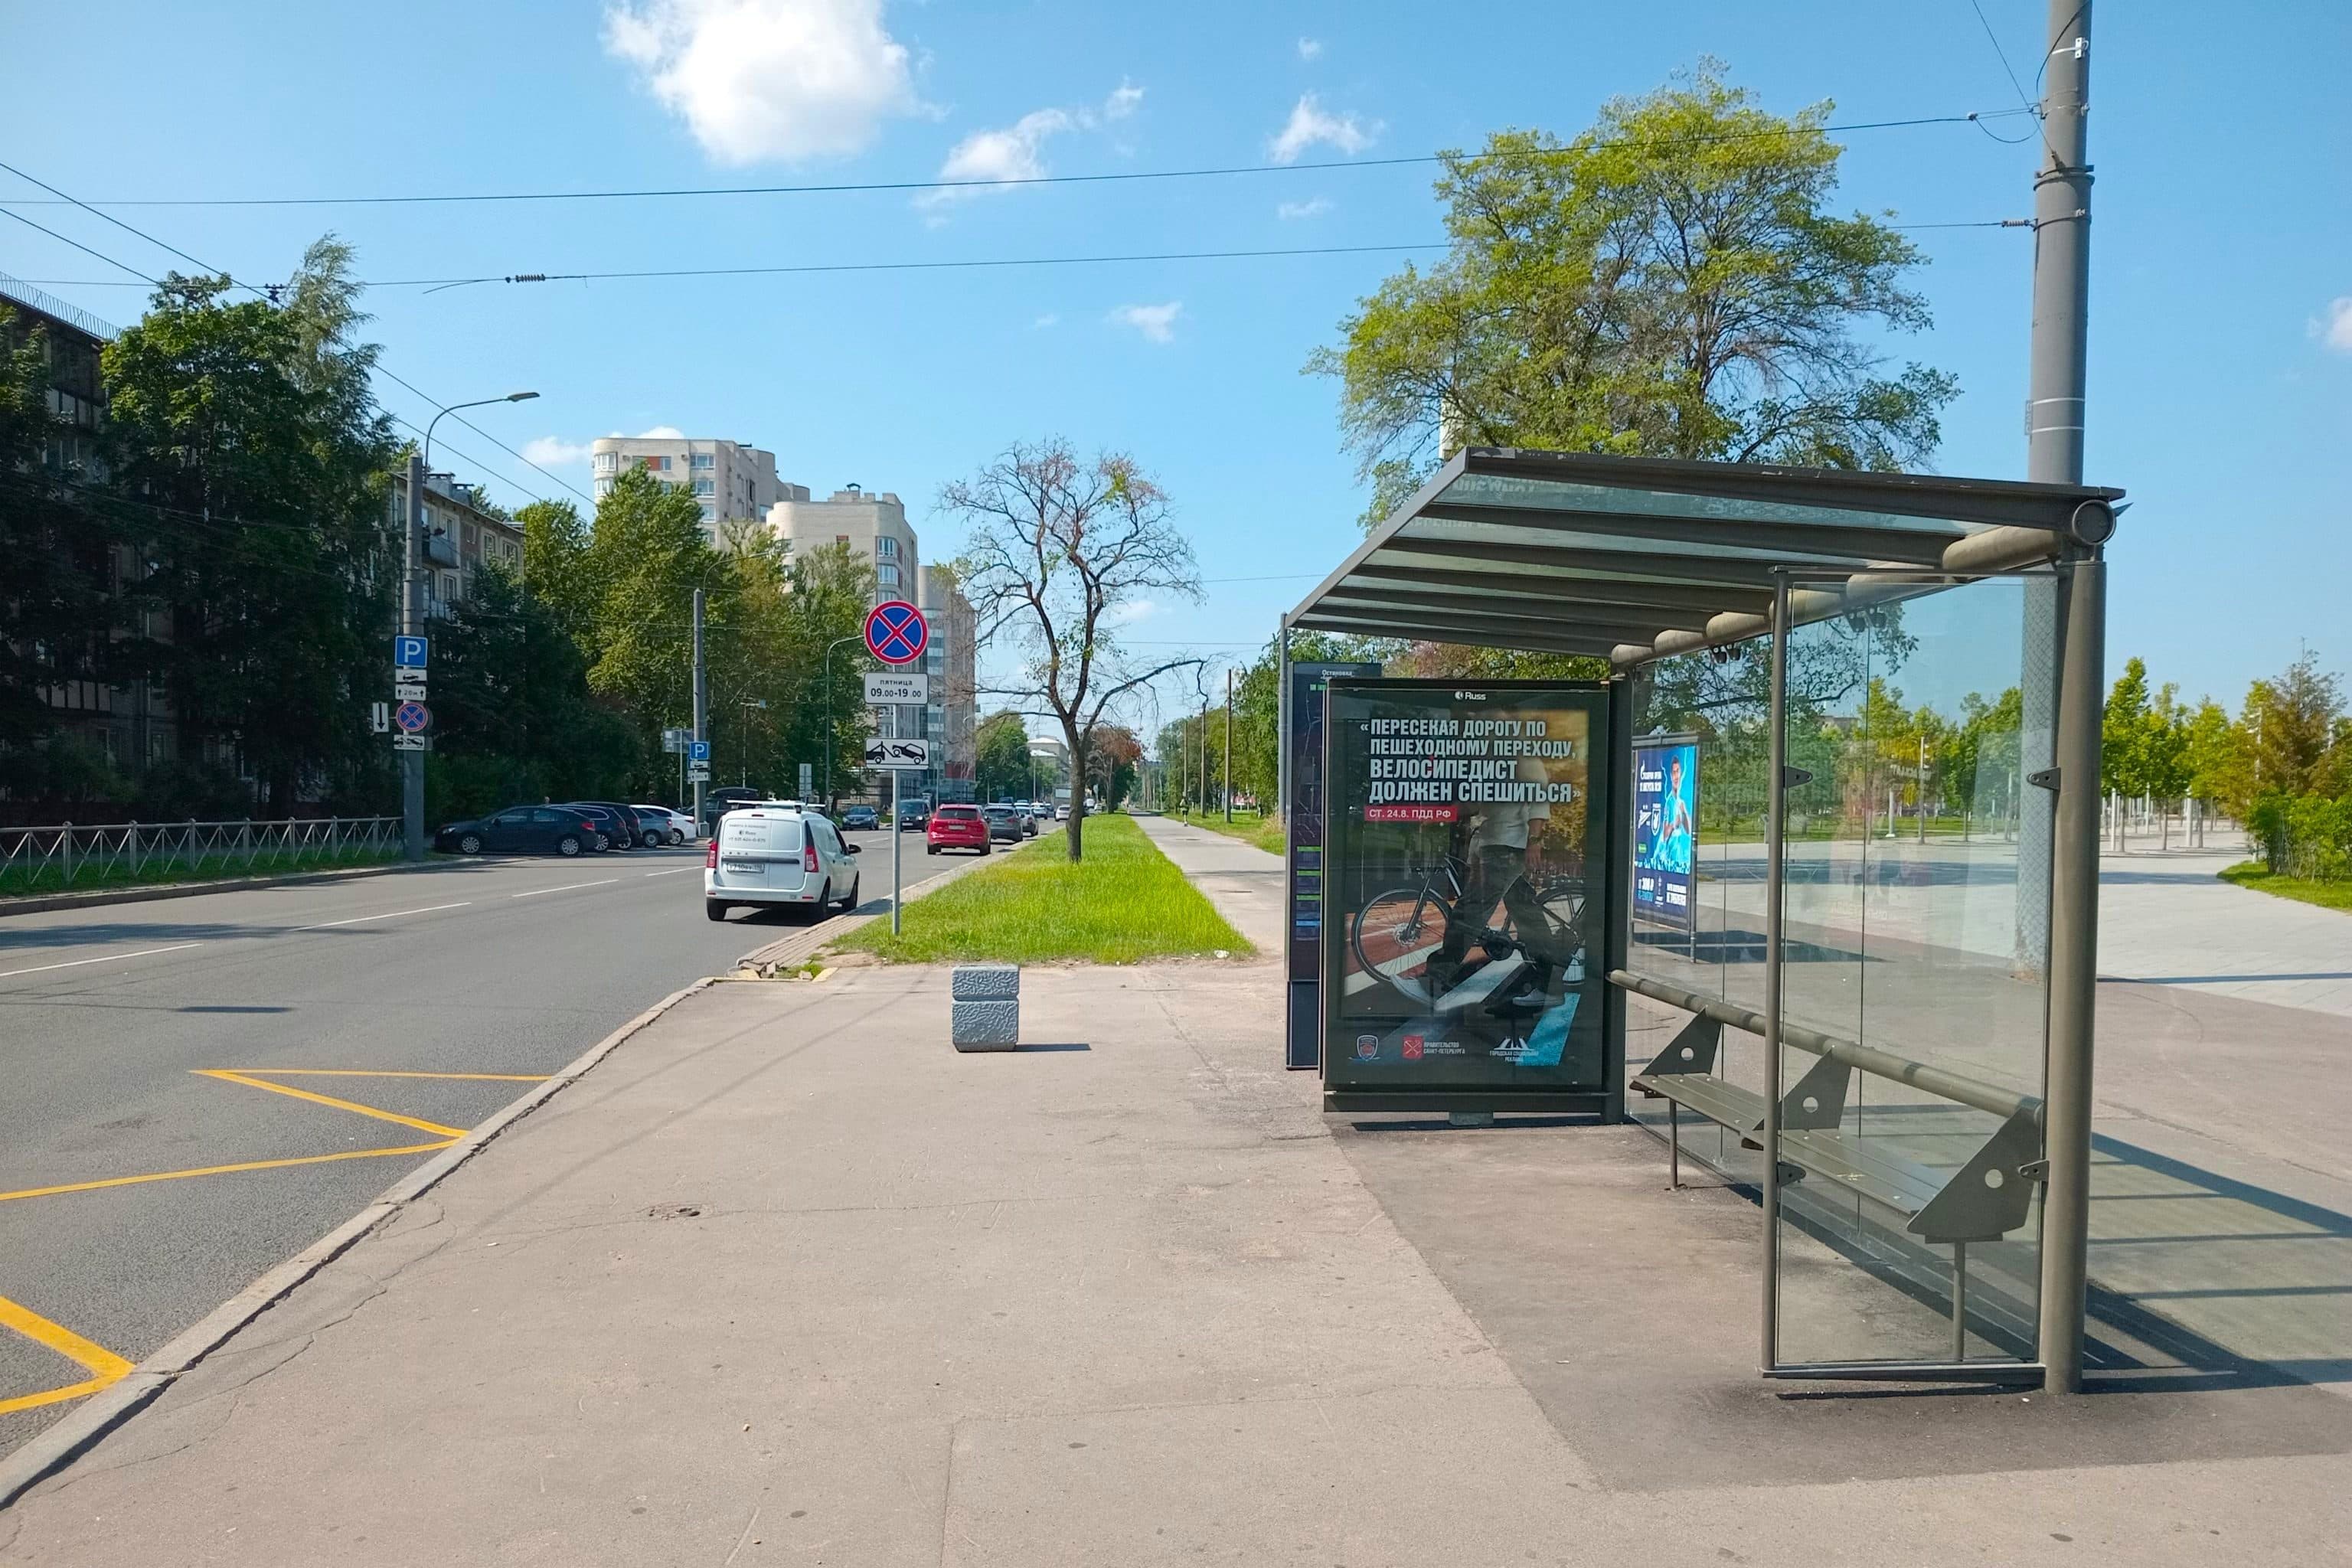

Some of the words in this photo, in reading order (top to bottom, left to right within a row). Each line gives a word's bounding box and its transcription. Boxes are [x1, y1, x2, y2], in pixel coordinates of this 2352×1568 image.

[404, 640, 421, 663] P
[1465, 691, 1487, 701] Russ
[1360, 718, 1459, 736] «ПЕРЕСЕКАЯ
[1463, 720, 1521, 739] ДОРОГУ
[1526, 720, 1546, 737] ПО
[694, 743, 705, 757] P
[1370, 738, 1489, 758] ПЕШЕХОДНОМУ
[1493, 740, 1576, 760] ПЕРЕХОДУ,
[1370, 759, 1517, 782] ВЕЛОСИПЕДИСТ
[1369, 781, 1452, 804] ДОЛЖЕН
[1458, 782, 1580, 802] СПЕШИТЬСЯ»
[1369, 808, 1385, 818] СТ.
[1387, 809, 1410, 818] 24.8.
[1412, 809, 1433, 819] ПДД
[1436, 809, 1452, 818] РФ
